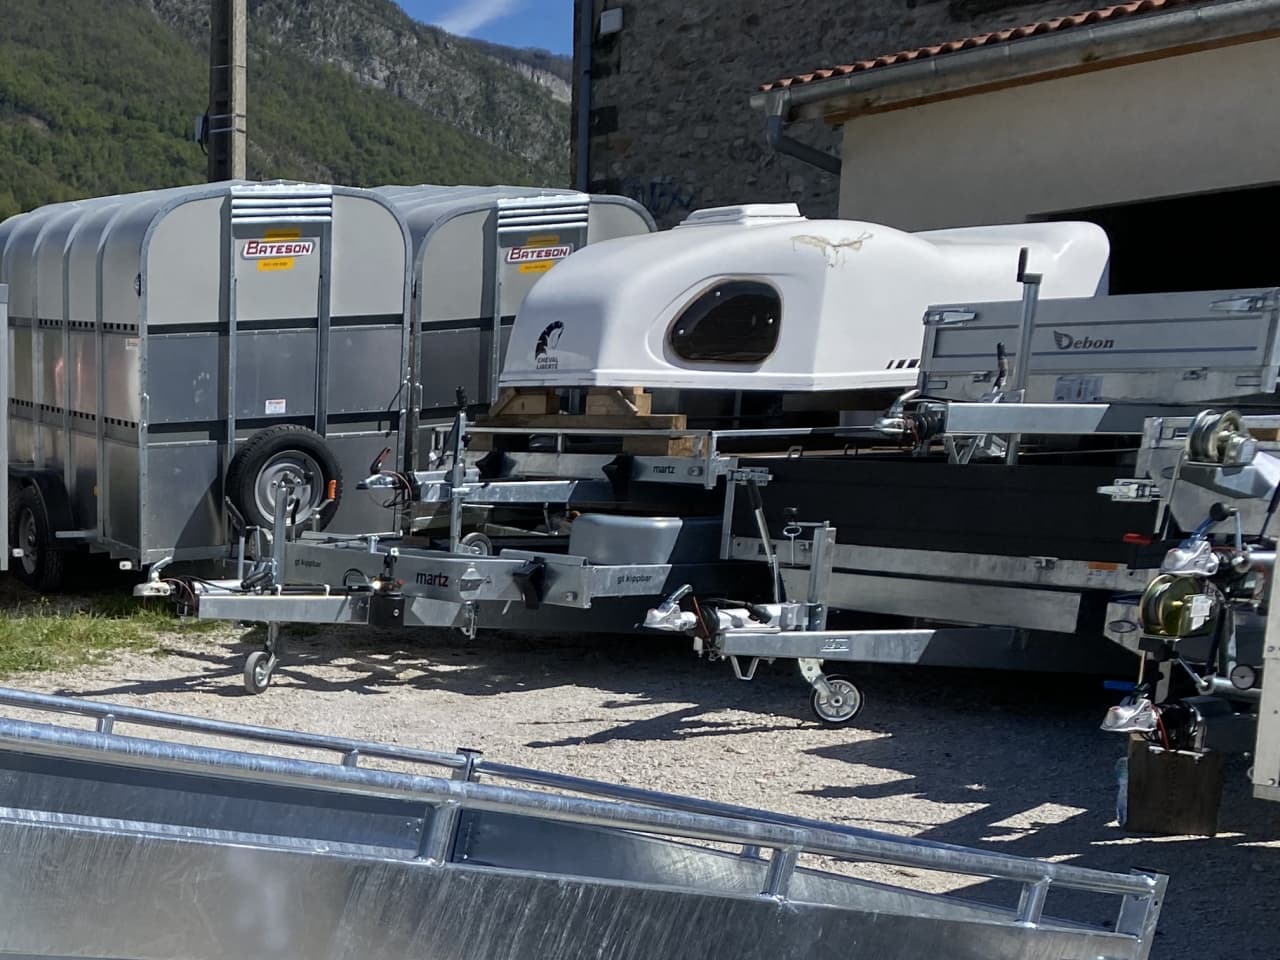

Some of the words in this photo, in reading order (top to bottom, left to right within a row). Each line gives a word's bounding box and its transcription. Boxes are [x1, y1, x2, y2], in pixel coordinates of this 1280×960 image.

[246, 240, 311, 255] BATESON
[509, 247, 568, 260] BATESON
[1053, 330, 1115, 350] Debon
[416, 571, 450, 588] martz
